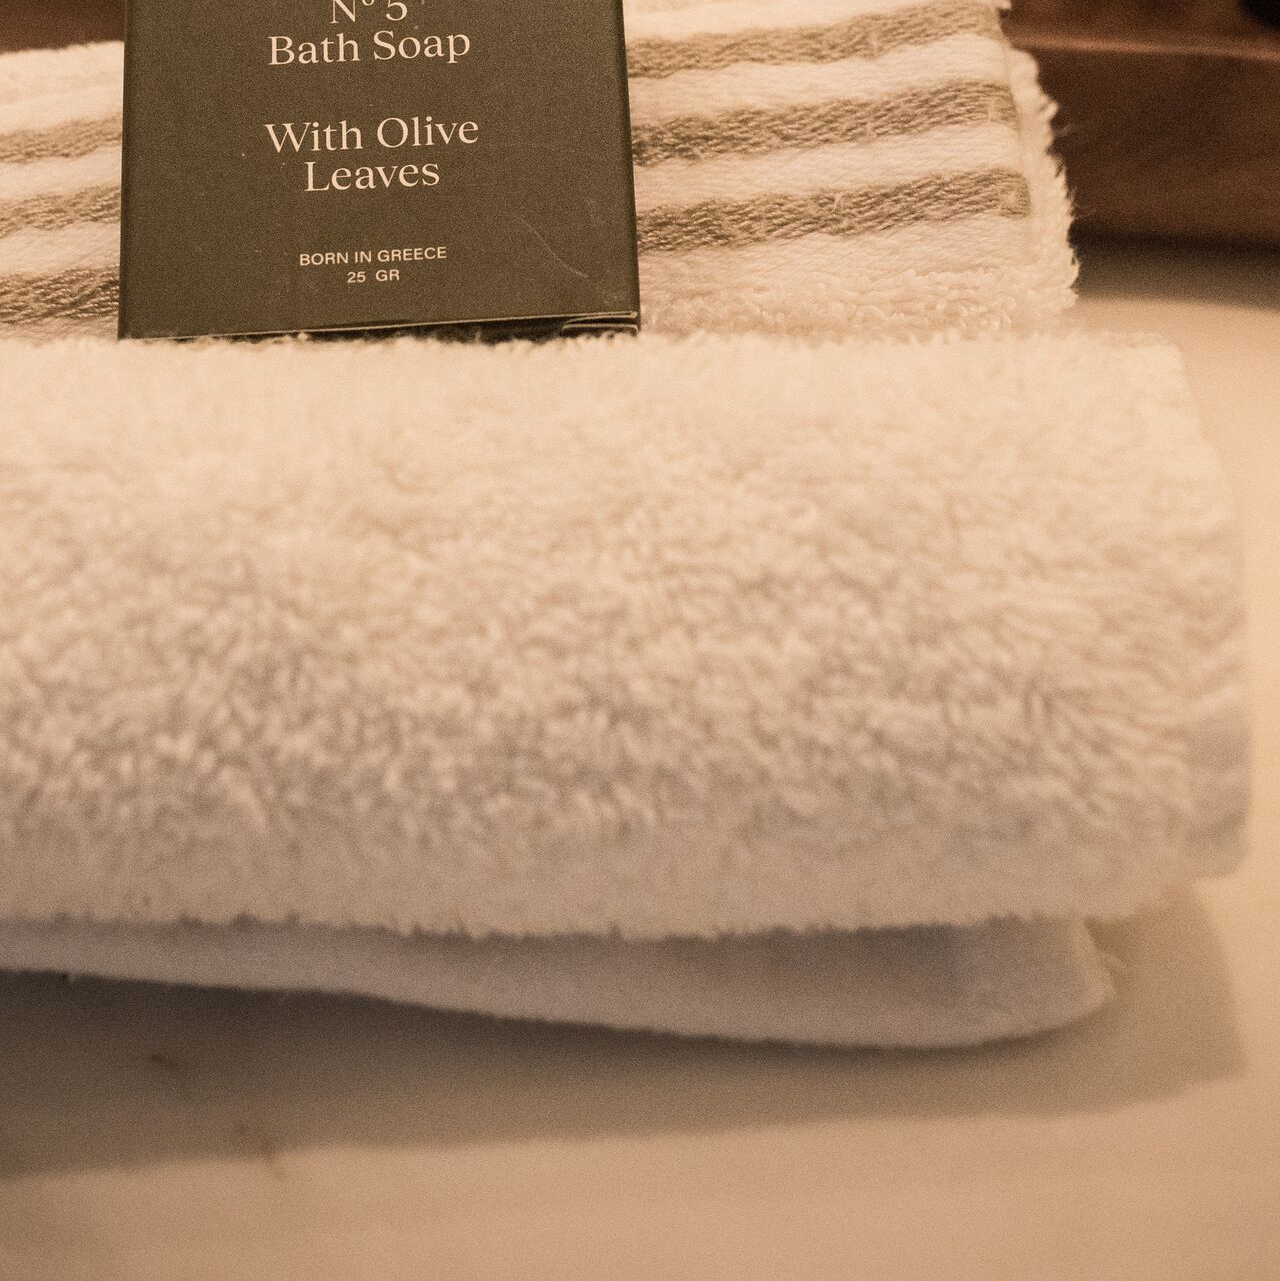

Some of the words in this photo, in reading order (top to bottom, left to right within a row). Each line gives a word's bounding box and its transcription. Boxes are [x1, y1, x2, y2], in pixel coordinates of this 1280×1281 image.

[268, 32, 361, 66] Bath
[373, 30, 471, 64] Soap
[264, 119, 363, 153] With
[376, 115, 479, 149] Olive
[304, 161, 440, 192] Leaves
[299, 252, 349, 267] BORN
[354, 250, 372, 263] IN
[377, 246, 447, 263] GREECE
[347, 271, 367, 284] 25
[375, 268, 400, 282] GR
